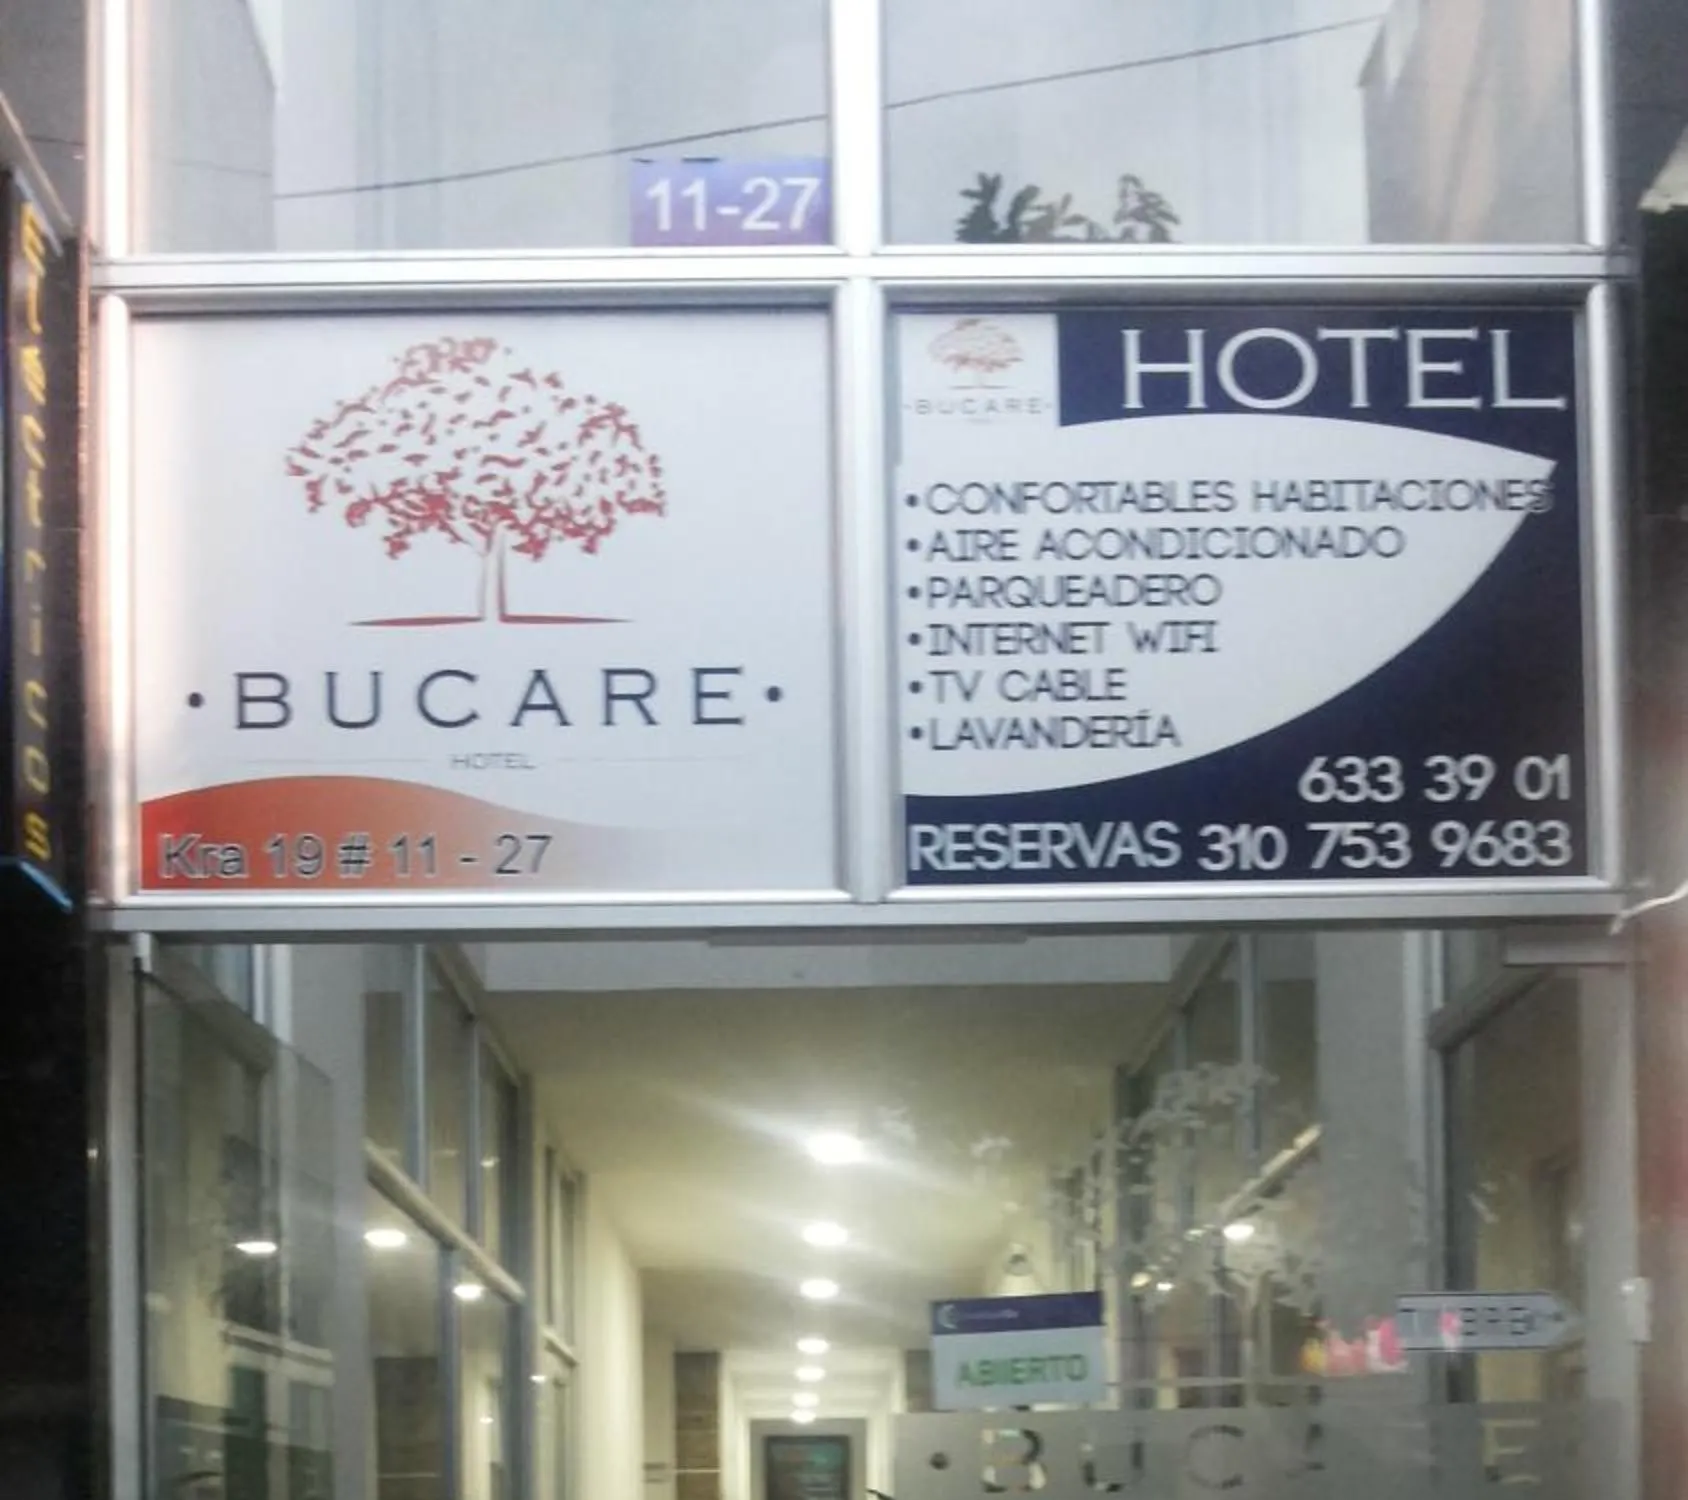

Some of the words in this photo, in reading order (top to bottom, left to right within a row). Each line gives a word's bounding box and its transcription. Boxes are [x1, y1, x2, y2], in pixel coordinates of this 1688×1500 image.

[644, 176, 823, 232] 11-27
[1121, 327, 1568, 411] HOTEL
[925, 482, 1237, 515] CONFORTABLES
[1253, 480, 1556, 513] HABITACIONES
[925, 529, 1020, 561] AIRE
[1033, 526, 1407, 560] ACONDICIONADO
[926, 575, 1223, 608] PARQUEADERO
[927, 622, 1110, 656] INTERNET
[1131, 621, 1220, 653] WIFI
[234, 667, 745, 729] BUCARE
[929, 670, 981, 702] TV
[1000, 669, 1127, 700] CABLE
[929, 711, 1182, 750] LAVANDERÍA
[450, 752, 536, 769] HOTEL
[1299, 756, 1403, 802] 633
[1423, 755, 1496, 801] 39
[1514, 754, 1571, 800] 01
[160, 835, 249, 878] Kra
[268, 835, 324, 876] 19
[391, 836, 440, 875] 11
[494, 836, 552, 875] 27
[908, 821, 1182, 872] RESERVAS
[1198, 823, 1288, 870] 310
[1307, 822, 1412, 869] 753
[1431, 820, 1573, 868] 9683
